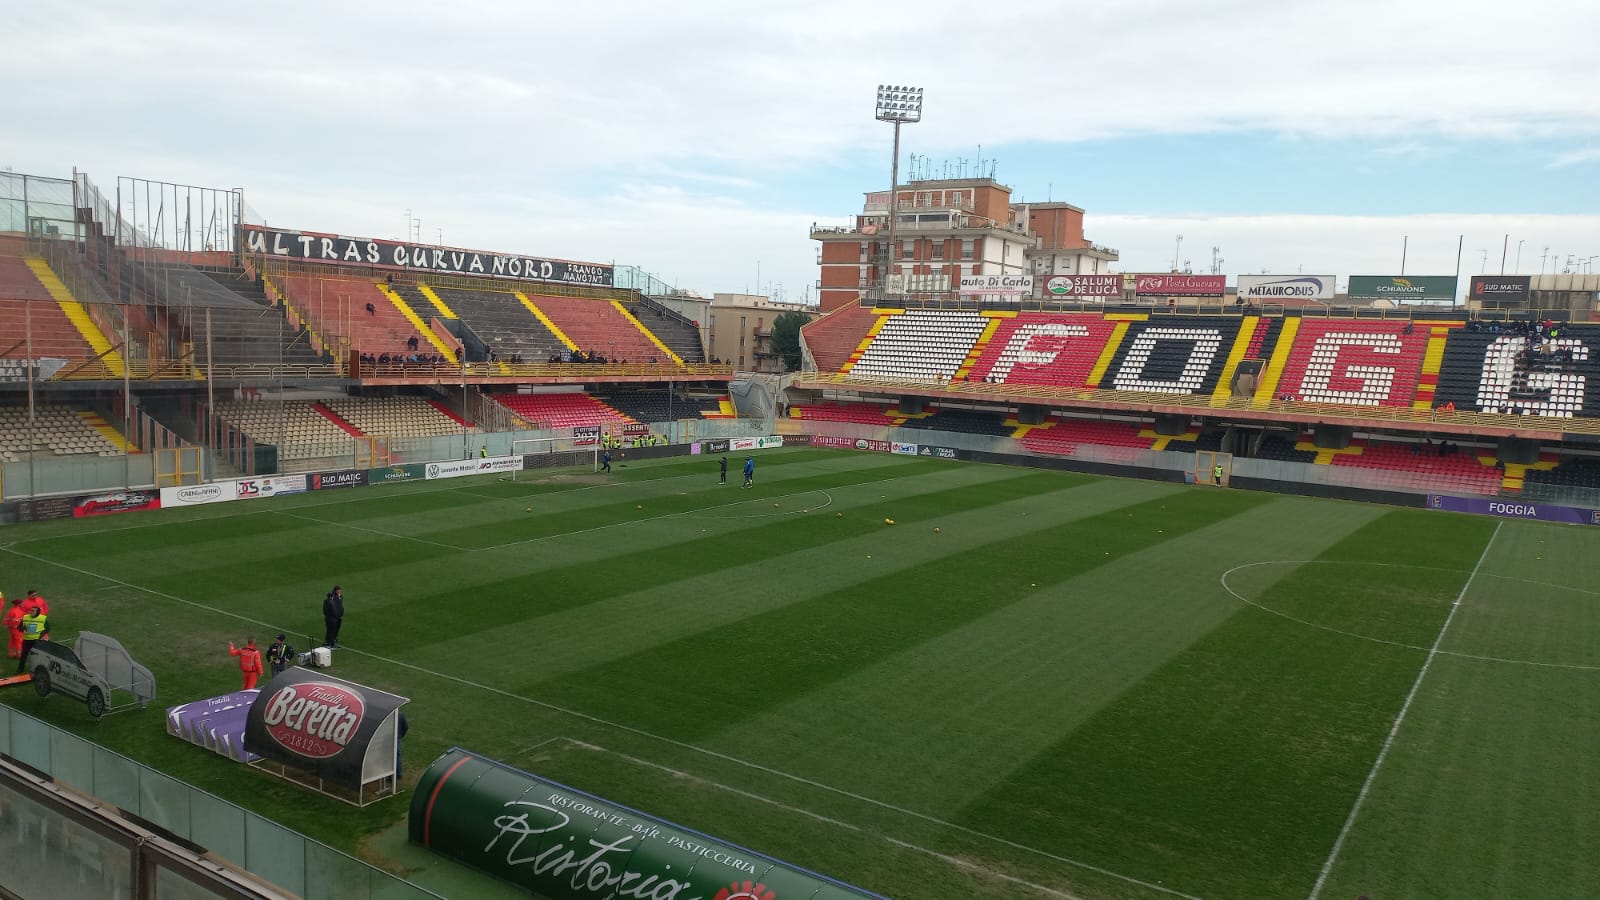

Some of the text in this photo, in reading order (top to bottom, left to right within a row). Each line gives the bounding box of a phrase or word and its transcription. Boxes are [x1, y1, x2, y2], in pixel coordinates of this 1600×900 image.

[247, 230, 553, 278] ULTRAS CURVA NORD
[961, 278, 985, 287] auto
[988, 276, 1000, 287] Di
[1002, 276, 1031, 287] Carlo
[1074, 277, 1117, 286] SALUMI
[1165, 277, 1221, 288] Posta Guevara
[1074, 286, 1118, 294] DE LUCA
[1247, 286, 1315, 296] METAUROBUS
[1500, 284, 1524, 292] MATIC
[322, 475, 336, 484] SUD
[338, 472, 361, 483] MATIC
[1489, 502, 1537, 517] FOGGIA
[264, 687, 357, 744] Beretta
[290, 736, 314, 753] 1812
[547, 793, 628, 827] RISTORANTE
[632, 822, 662, 839] BAR
[668, 834, 757, 876] PASTICCERIA
